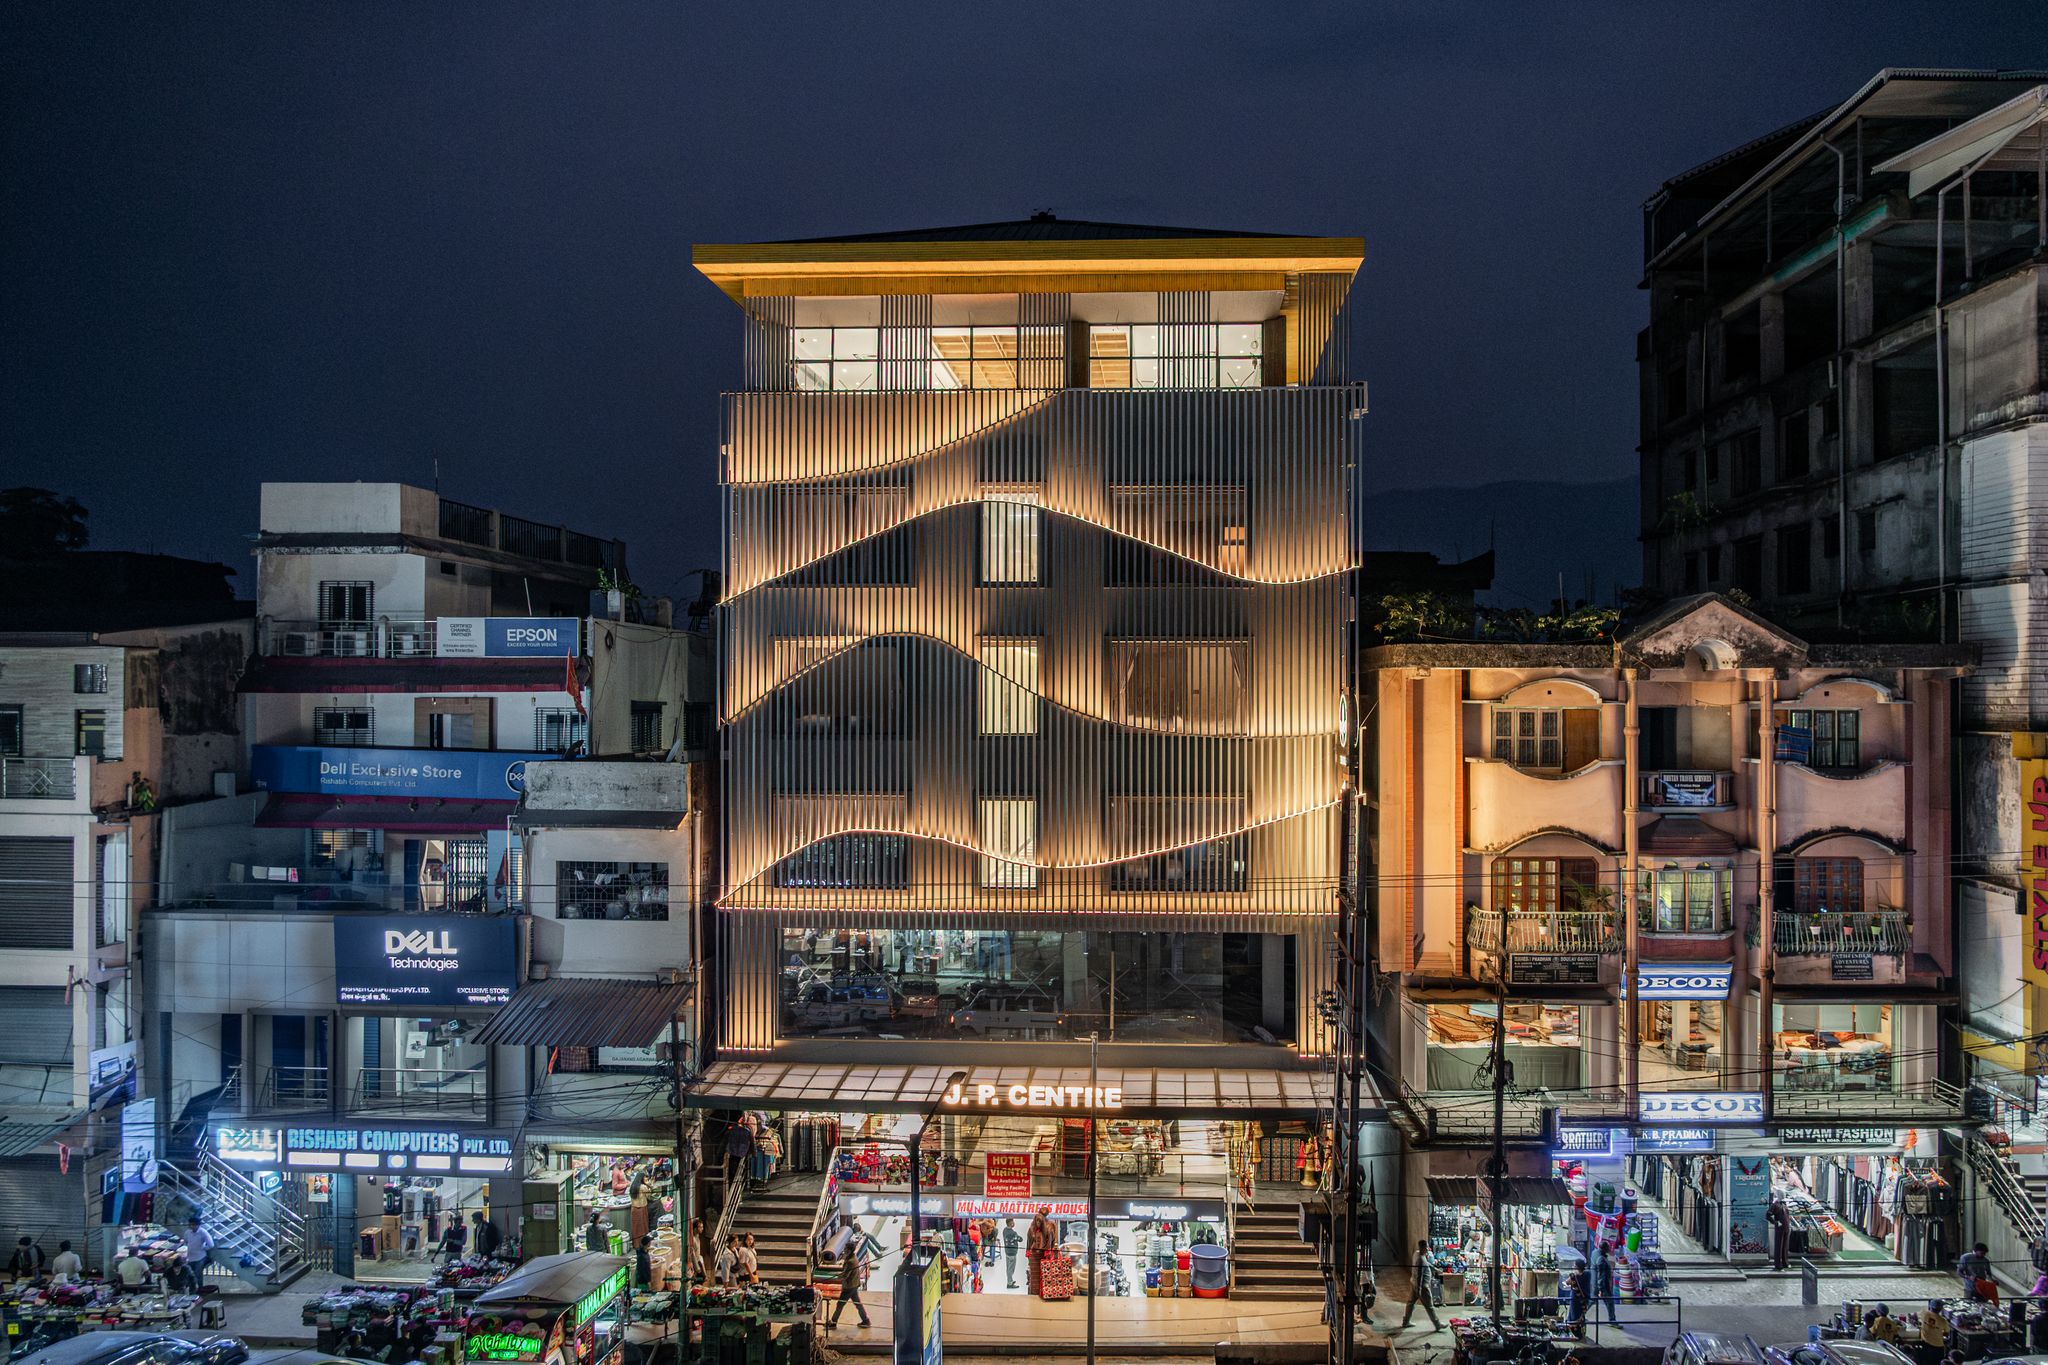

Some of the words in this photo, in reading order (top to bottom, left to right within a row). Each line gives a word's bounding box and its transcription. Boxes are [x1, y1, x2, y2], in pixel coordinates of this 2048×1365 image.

[506, 628, 558, 642] EPSON
[320, 762, 347, 775] Dell
[422, 765, 462, 779] Store
[320, 778, 348, 786] Rishabh
[349, 779, 387, 787] Computers
[2028, 776, 2048, 832] UP
[2032, 845, 2048, 974] STYLE
[385, 930, 458, 954] DELL
[388, 957, 458, 971] Technologies
[1638, 977, 1728, 988] DECOR
[944, 1084, 968, 1105] J.
[978, 1084, 999, 1105] P.
[1008, 1086, 1122, 1108] CENTRE
[1641, 1098, 1762, 1112] DECOR
[1642, 1130, 1651, 1139] K.
[1652, 1130, 1661, 1139] B.
[1662, 1130, 1709, 1139] PRADHAN
[1786, 1128, 1832, 1138] SHYAM
[1836, 1128, 1893, 1138] FASHION
[216, 1128, 277, 1150] DELL
[287, 1128, 358, 1150] RISHABH
[361, 1130, 459, 1153] COMPUTERS
[462, 1139, 487, 1154] PVT.
[1562, 1132, 1608, 1150] BROTHERS
[992, 1156, 1026, 1165] HOTEL
[957, 1200, 996, 1214] MUNNA
[1055, 1202, 1088, 1214] HOUSE
